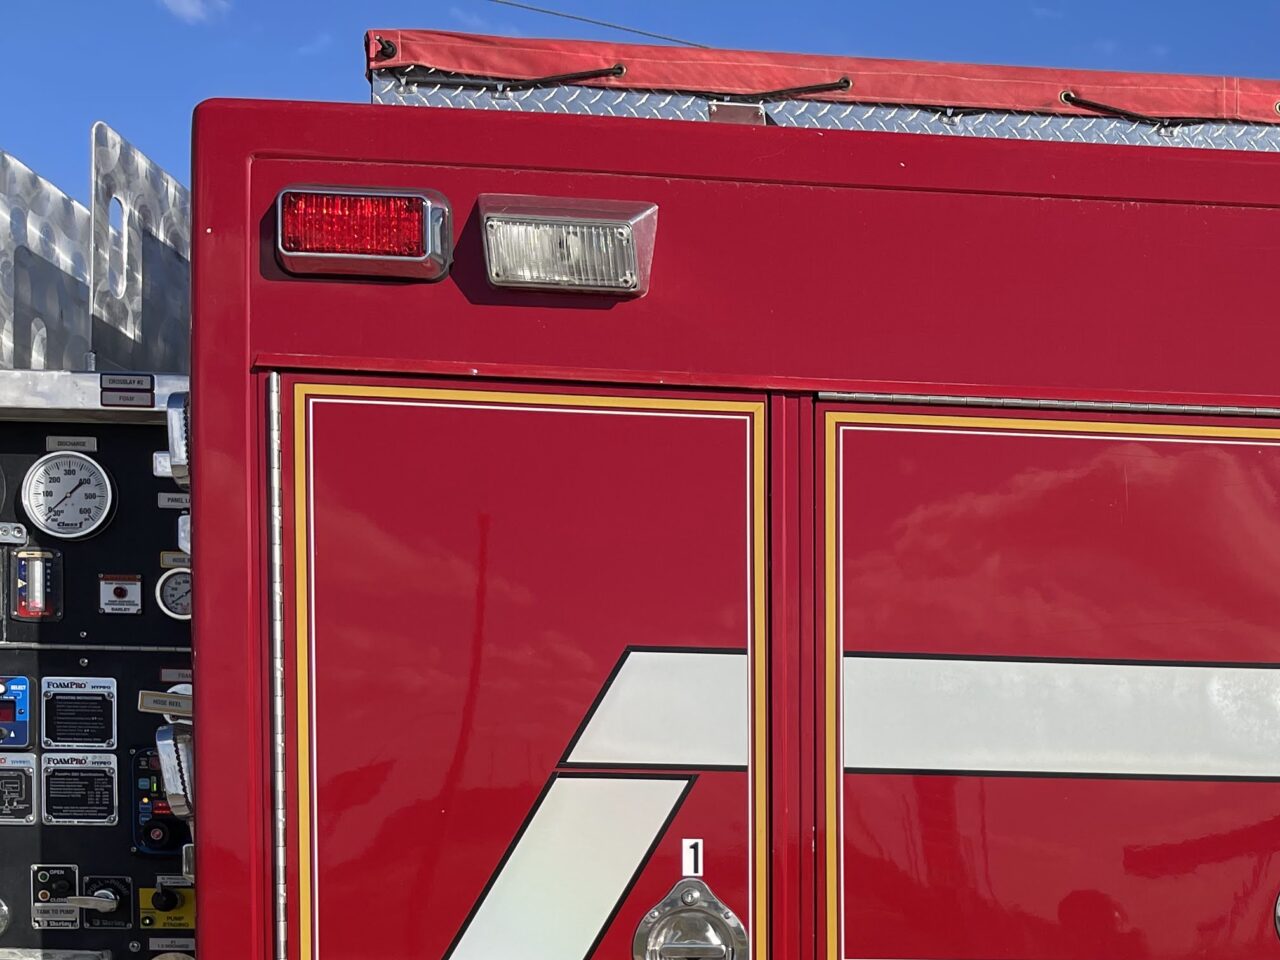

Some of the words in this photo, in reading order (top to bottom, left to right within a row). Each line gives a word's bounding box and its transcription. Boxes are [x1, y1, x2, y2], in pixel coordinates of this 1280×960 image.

[48, 476, 61, 484] 200
[42, 490, 53, 498] 100
[84, 492, 97, 500] 500
[79, 507, 92, 515] 600
[689, 841, 700, 874] 1
